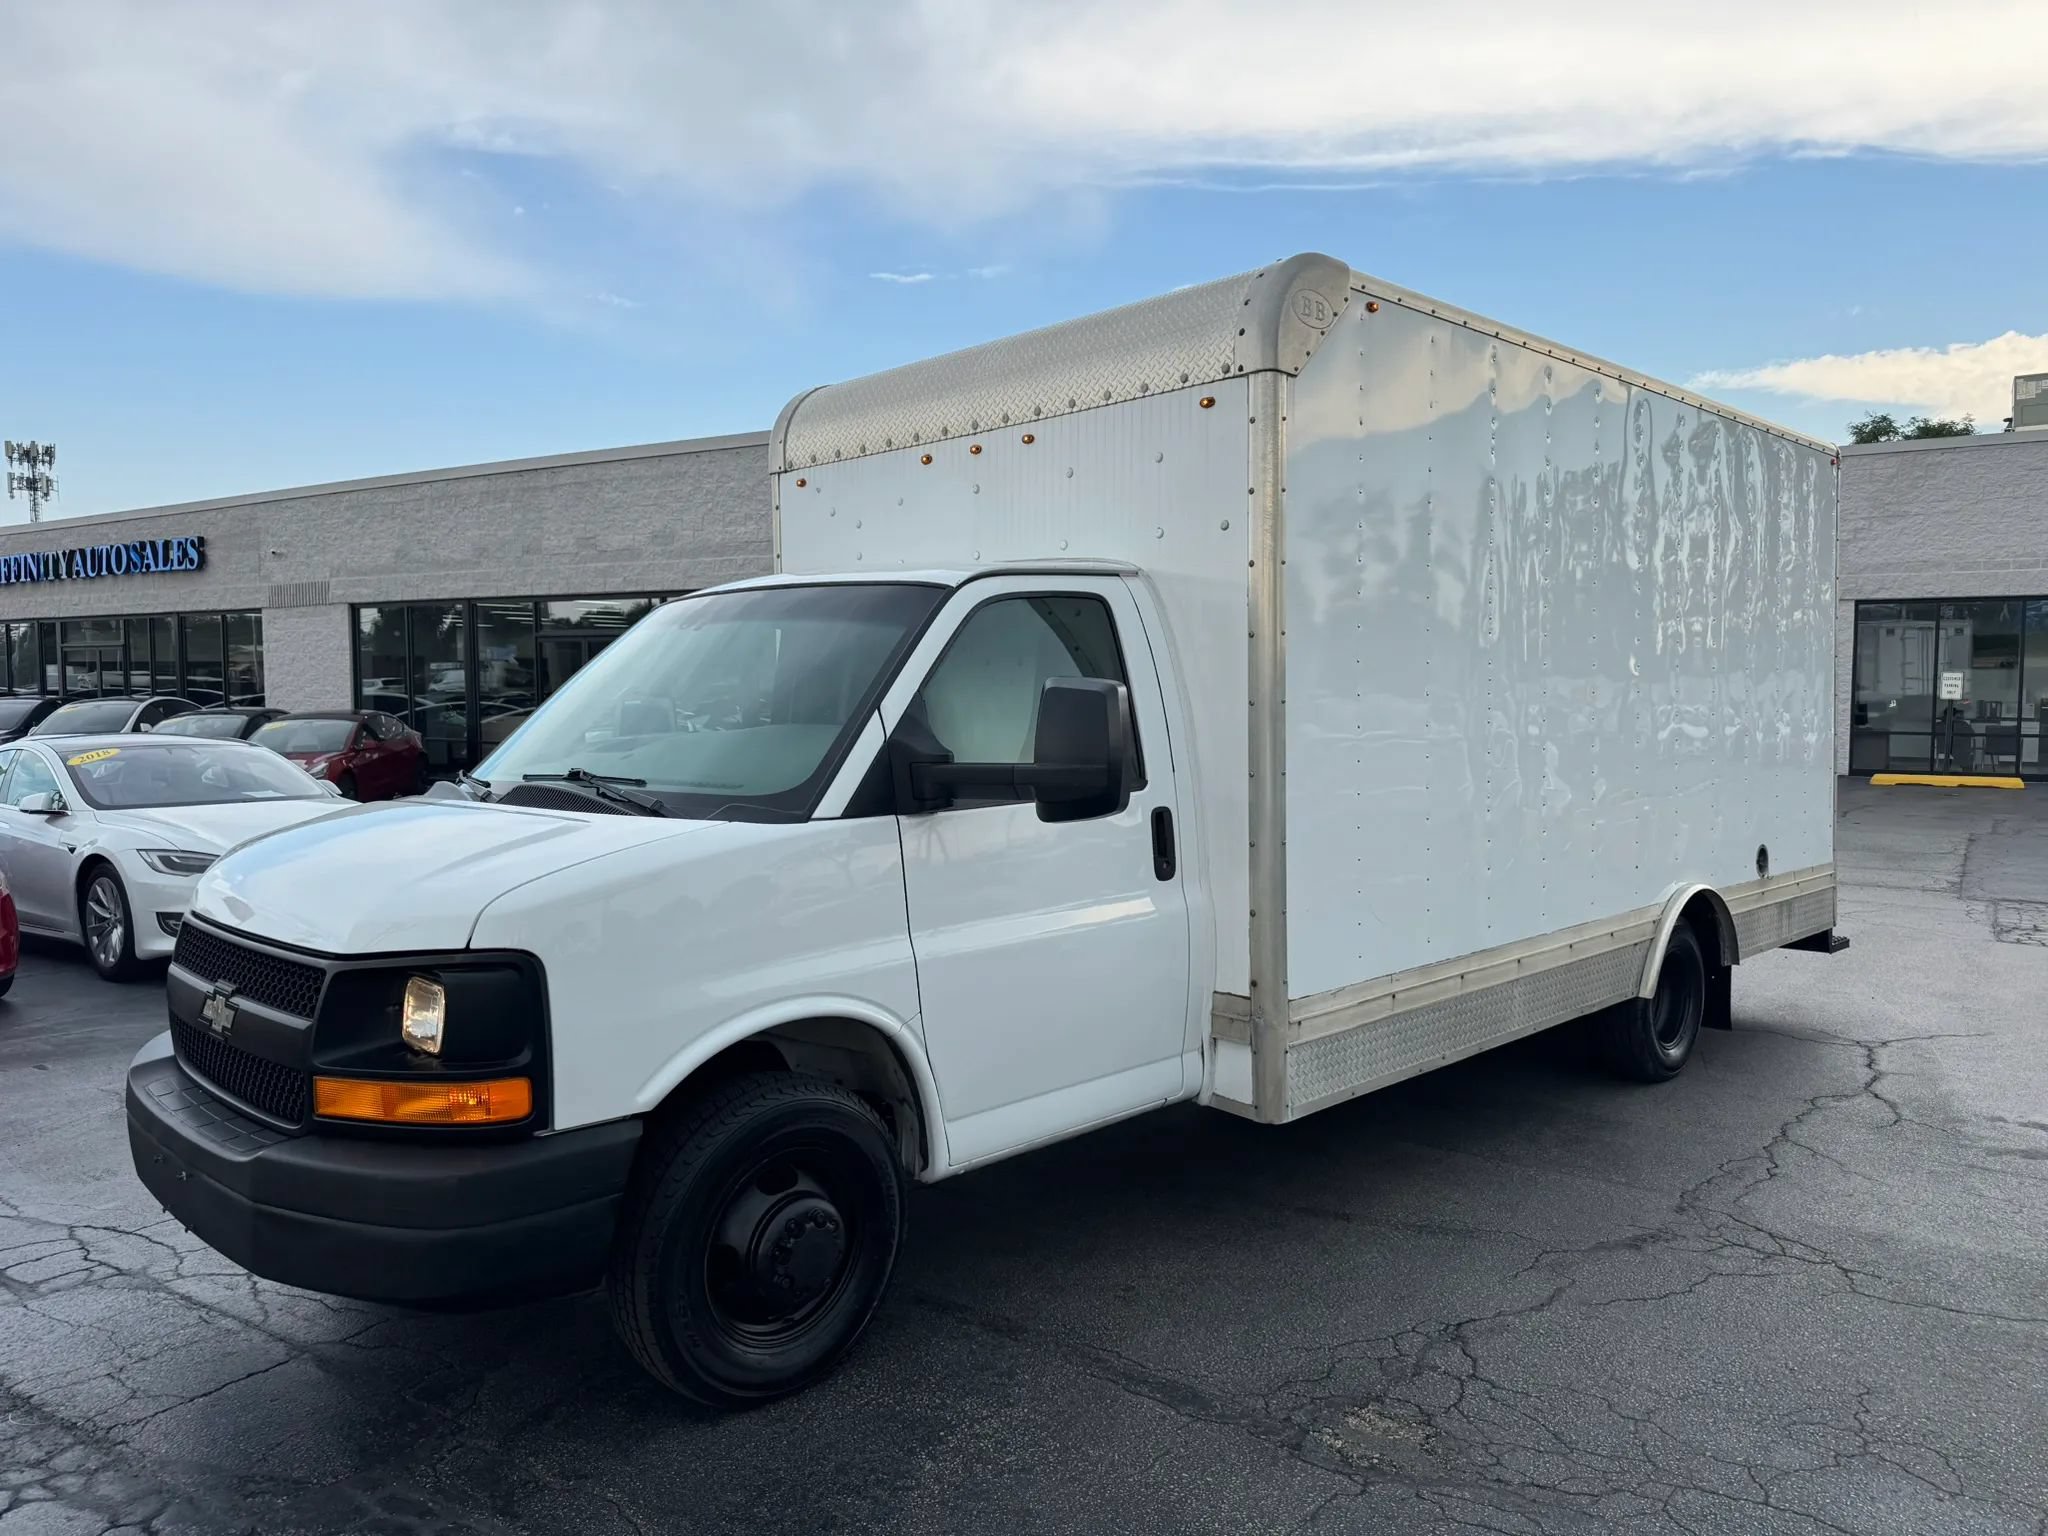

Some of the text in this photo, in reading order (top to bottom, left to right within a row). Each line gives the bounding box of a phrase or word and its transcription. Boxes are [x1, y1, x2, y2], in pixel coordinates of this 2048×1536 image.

[71, 544, 127, 579] AUTO
[129, 536, 200, 573] SALES
[79, 750, 111, 763] 2018
